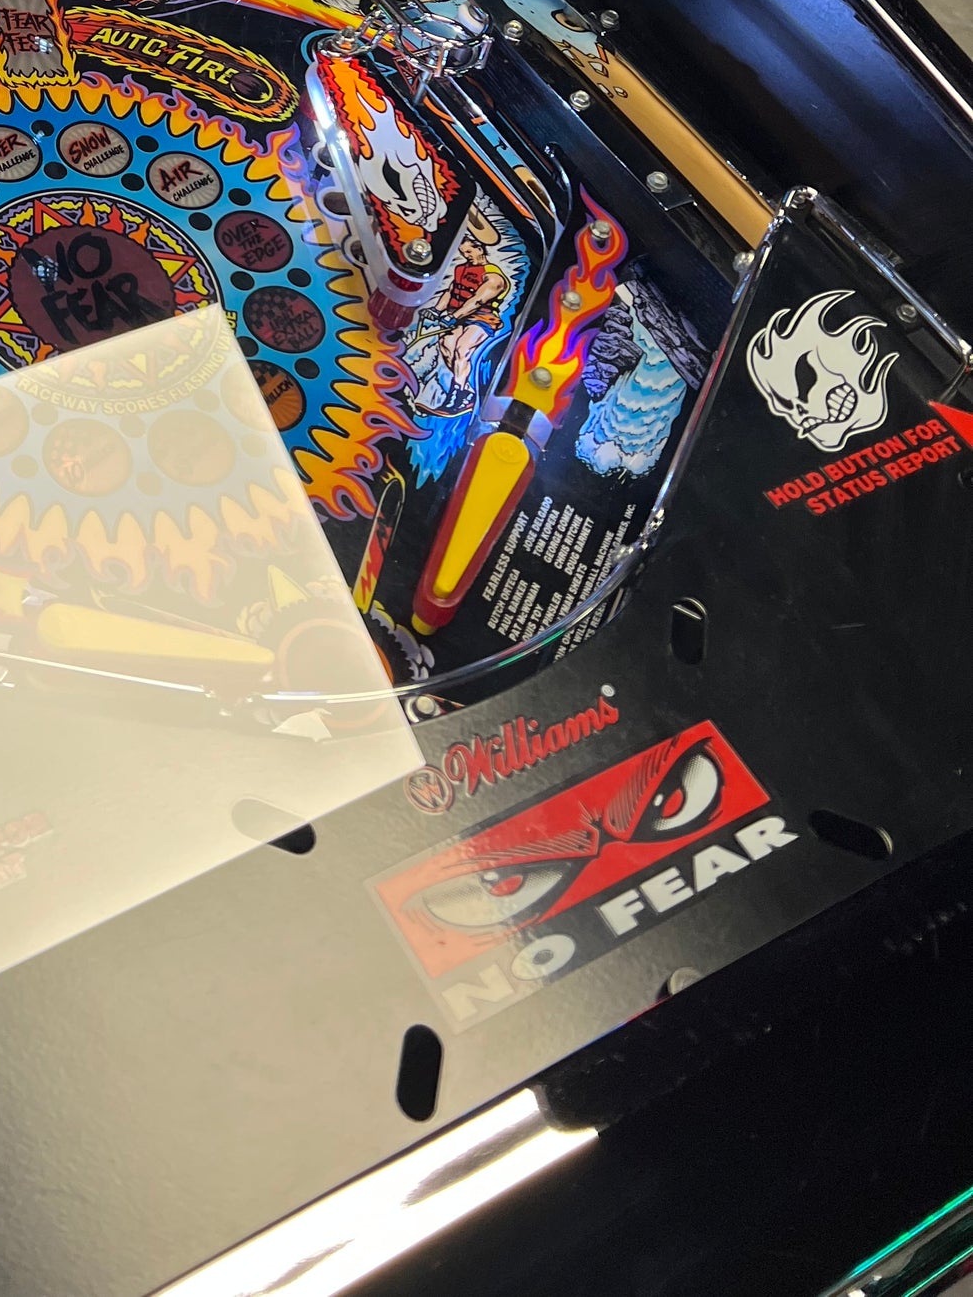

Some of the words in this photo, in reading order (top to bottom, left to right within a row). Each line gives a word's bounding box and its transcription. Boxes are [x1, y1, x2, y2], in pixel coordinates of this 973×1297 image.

[0, 9, 50, 32] FEAR
[91, 28, 168, 57] AUTO
[167, 43, 239, 85] FIRE
[68, 127, 112, 164] SNOW
[84, 145, 125, 171] CHALLENGE
[157, 159, 204, 192] AIR
[173, 174, 214, 201] CHALLENGE
[222, 218, 268, 247] OVER
[239, 233, 265, 250] THE
[244, 234, 287, 267] EDGE
[19, 232, 112, 294] NO
[41, 273, 173, 346] FEAR
[15, 377, 97, 414] RACEWAY
[103, 394, 168, 415] SCORES
[169, 352, 226, 401] FLASHING
[764, 472, 826, 508] HOLD
[823, 436, 907, 482] BUTTON
[902, 419, 947, 446] FOR
[807, 470, 888, 516] STATUS
[883, 436, 961, 480] REPORT
[523, 531, 536, 552] JOSE
[532, 496, 554, 532] DELGADO
[533, 539, 544, 557] TOM
[542, 509, 561, 539] KOPERA
[543, 532, 562, 564] GEORGE
[557, 504, 575, 533] GOMEZ
[553, 543, 568, 570] CHRIS
[564, 514, 583, 544] RITCHIE
[564, 552, 580, 576] DOUG
[575, 516, 595, 554] BARNETT
[482, 554, 511, 601] FEARLESS
[505, 510, 530, 555] SUPPORT
[581, 569, 601, 604] PINBALL
[594, 530, 615, 568] MACHINE
[487, 599, 503, 630] BUTCH
[500, 569, 521, 601] ORTEGA
[497, 610, 511, 635] PAUL
[508, 579, 528, 611] BARKER
[542, 592, 562, 628] PINSLER
[558, 590, 575, 621] YMAN
[568, 563, 588, 593] SHEATS
[508, 621, 522, 642] PAT
[522, 618, 538, 643] OUIS
[534, 604, 544, 620] TOY
[444, 696, 620, 797] Williams
[442, 933, 576, 1023] NO
[596, 815, 799, 937] FEAR
